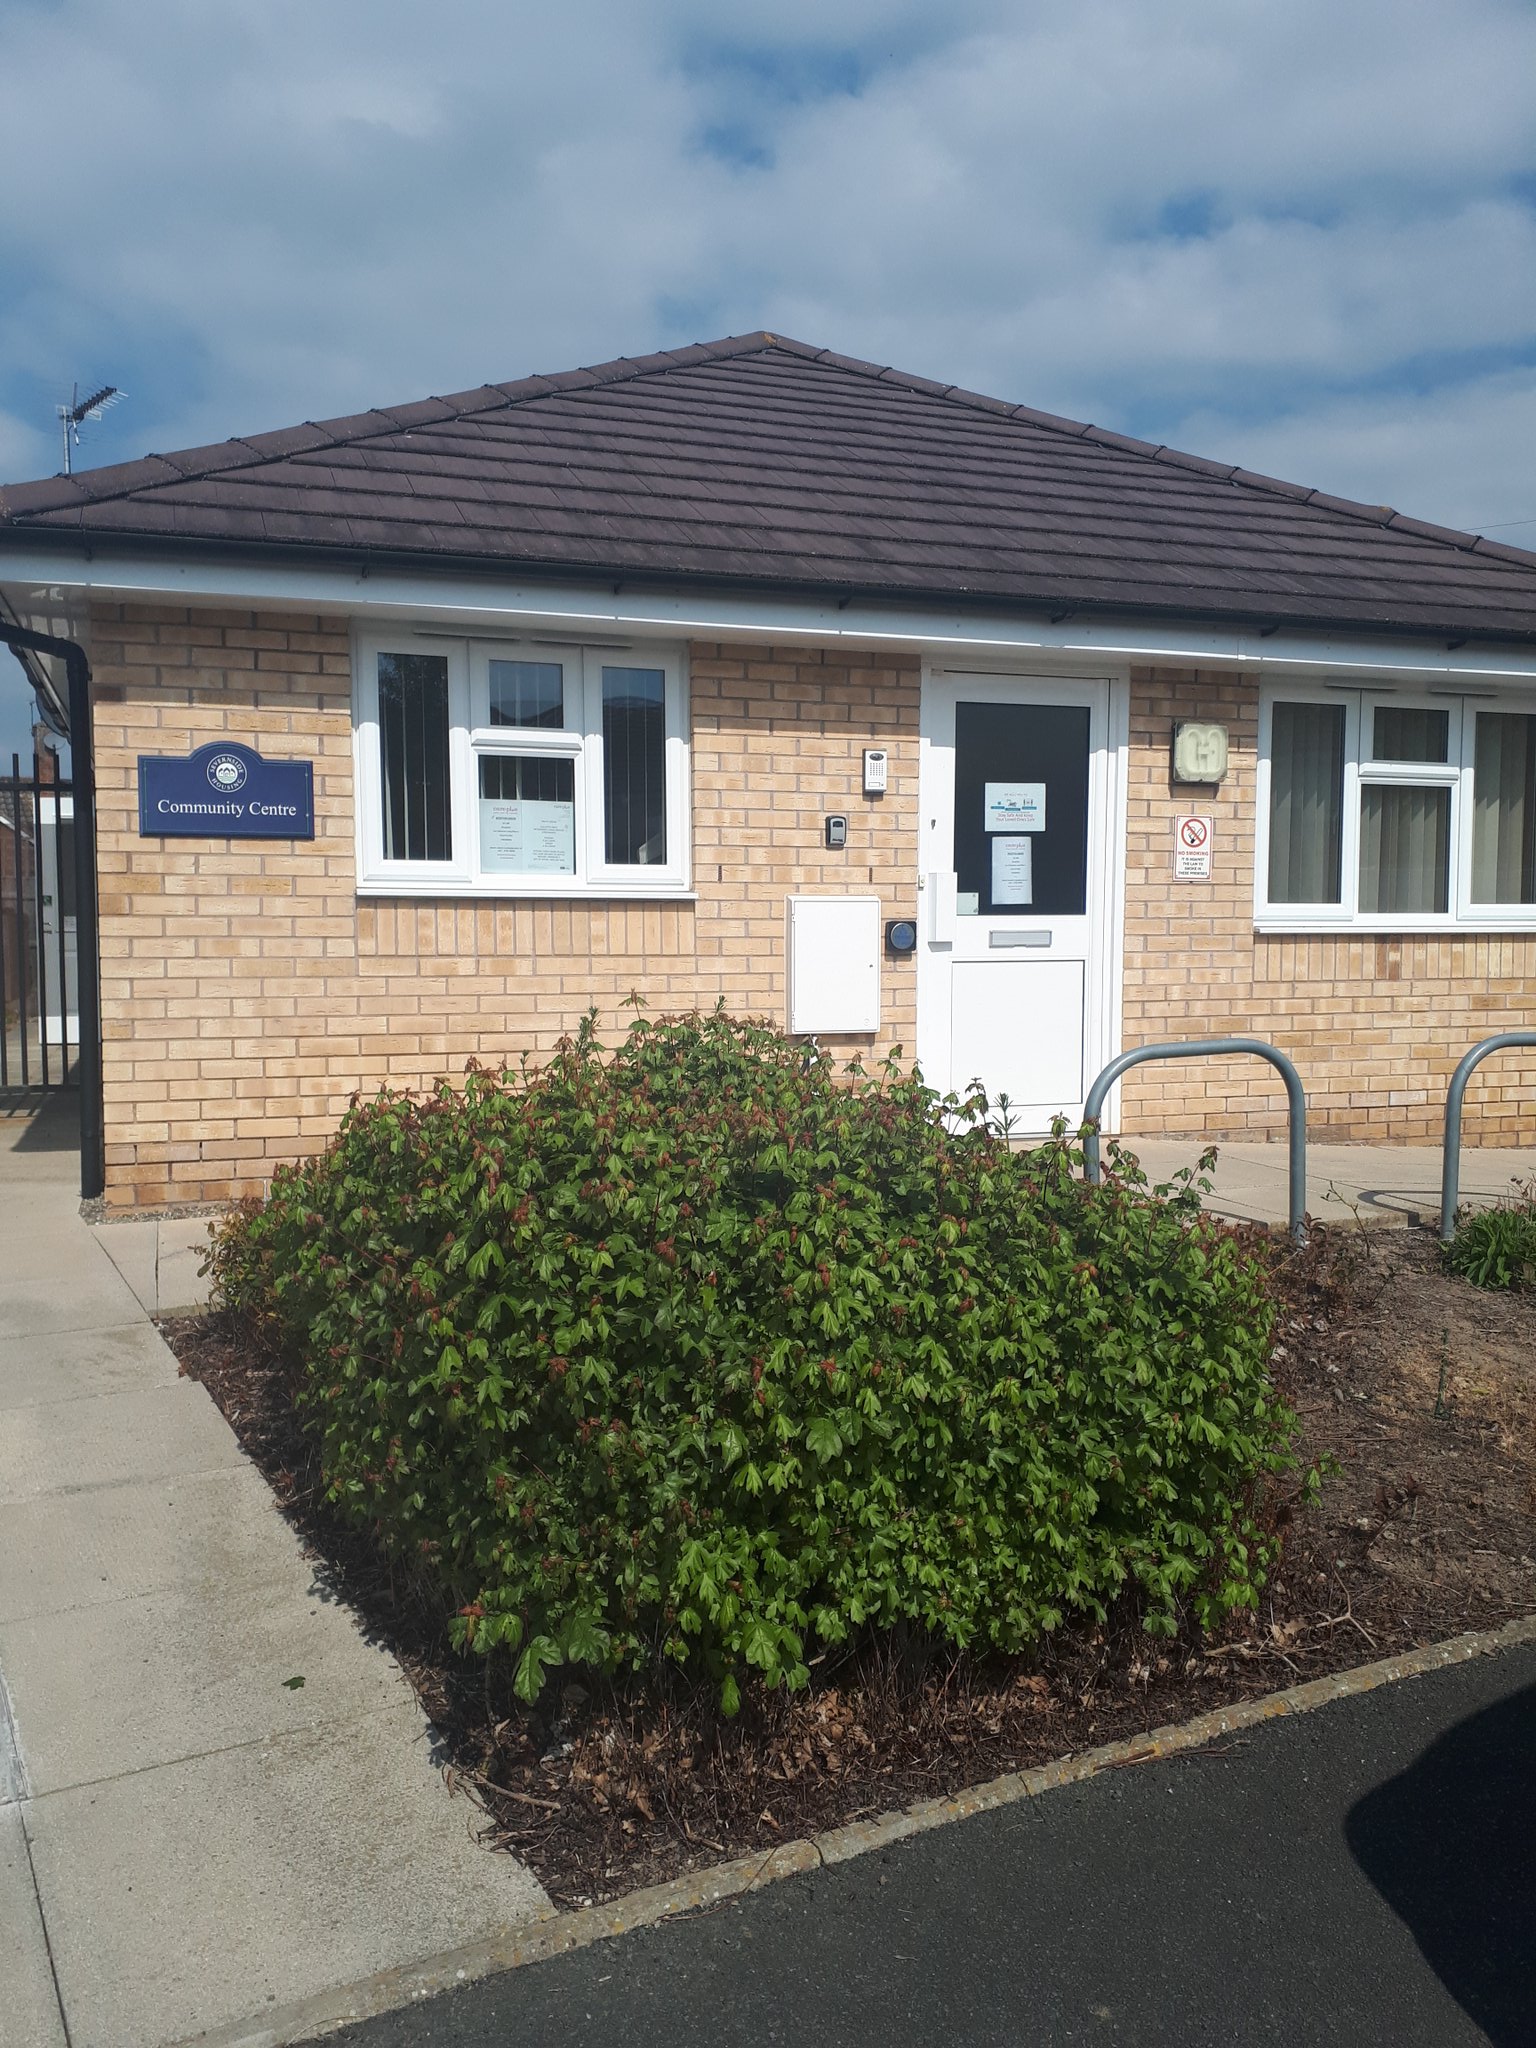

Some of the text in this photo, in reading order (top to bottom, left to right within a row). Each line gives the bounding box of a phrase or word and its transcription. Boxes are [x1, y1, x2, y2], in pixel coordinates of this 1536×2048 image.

[210, 756, 244, 774] SEVERNSIDE
[211, 778, 243, 790] HOUSING
[157, 799, 297, 818] Community Centre
